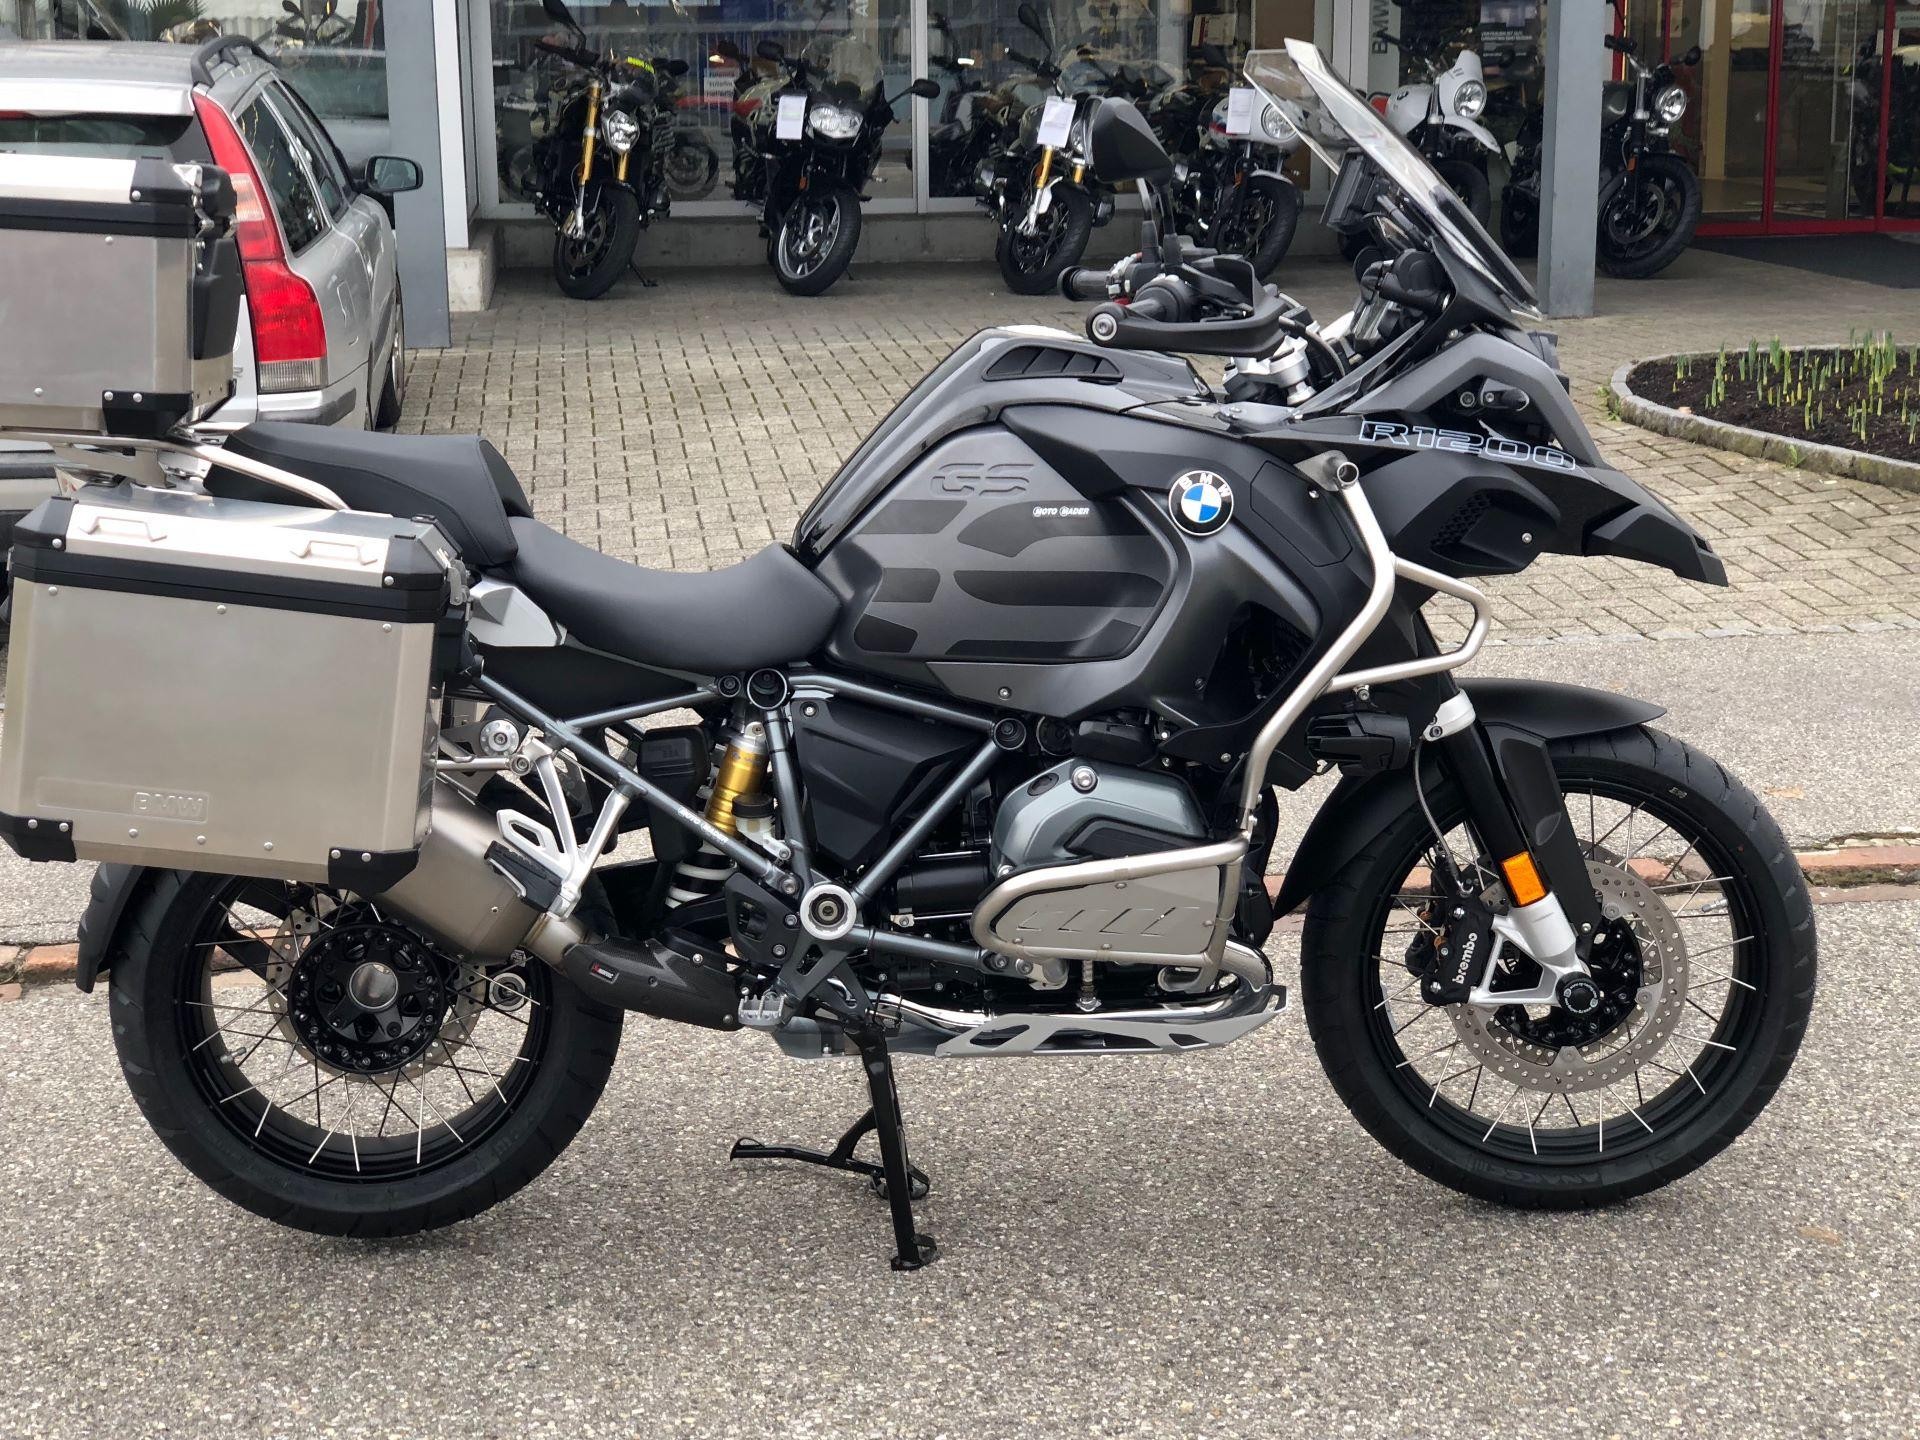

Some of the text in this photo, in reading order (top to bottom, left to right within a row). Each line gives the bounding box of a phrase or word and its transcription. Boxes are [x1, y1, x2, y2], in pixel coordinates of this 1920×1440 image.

[1359, 421, 1576, 471] R1200
[930, 463, 1034, 497] GS
[1178, 472, 1231, 498] BMW
[1033, 505, 1090, 518] MOTO MADER
[135, 791, 204, 817] BMW
[1452, 932, 1478, 985] brembo
